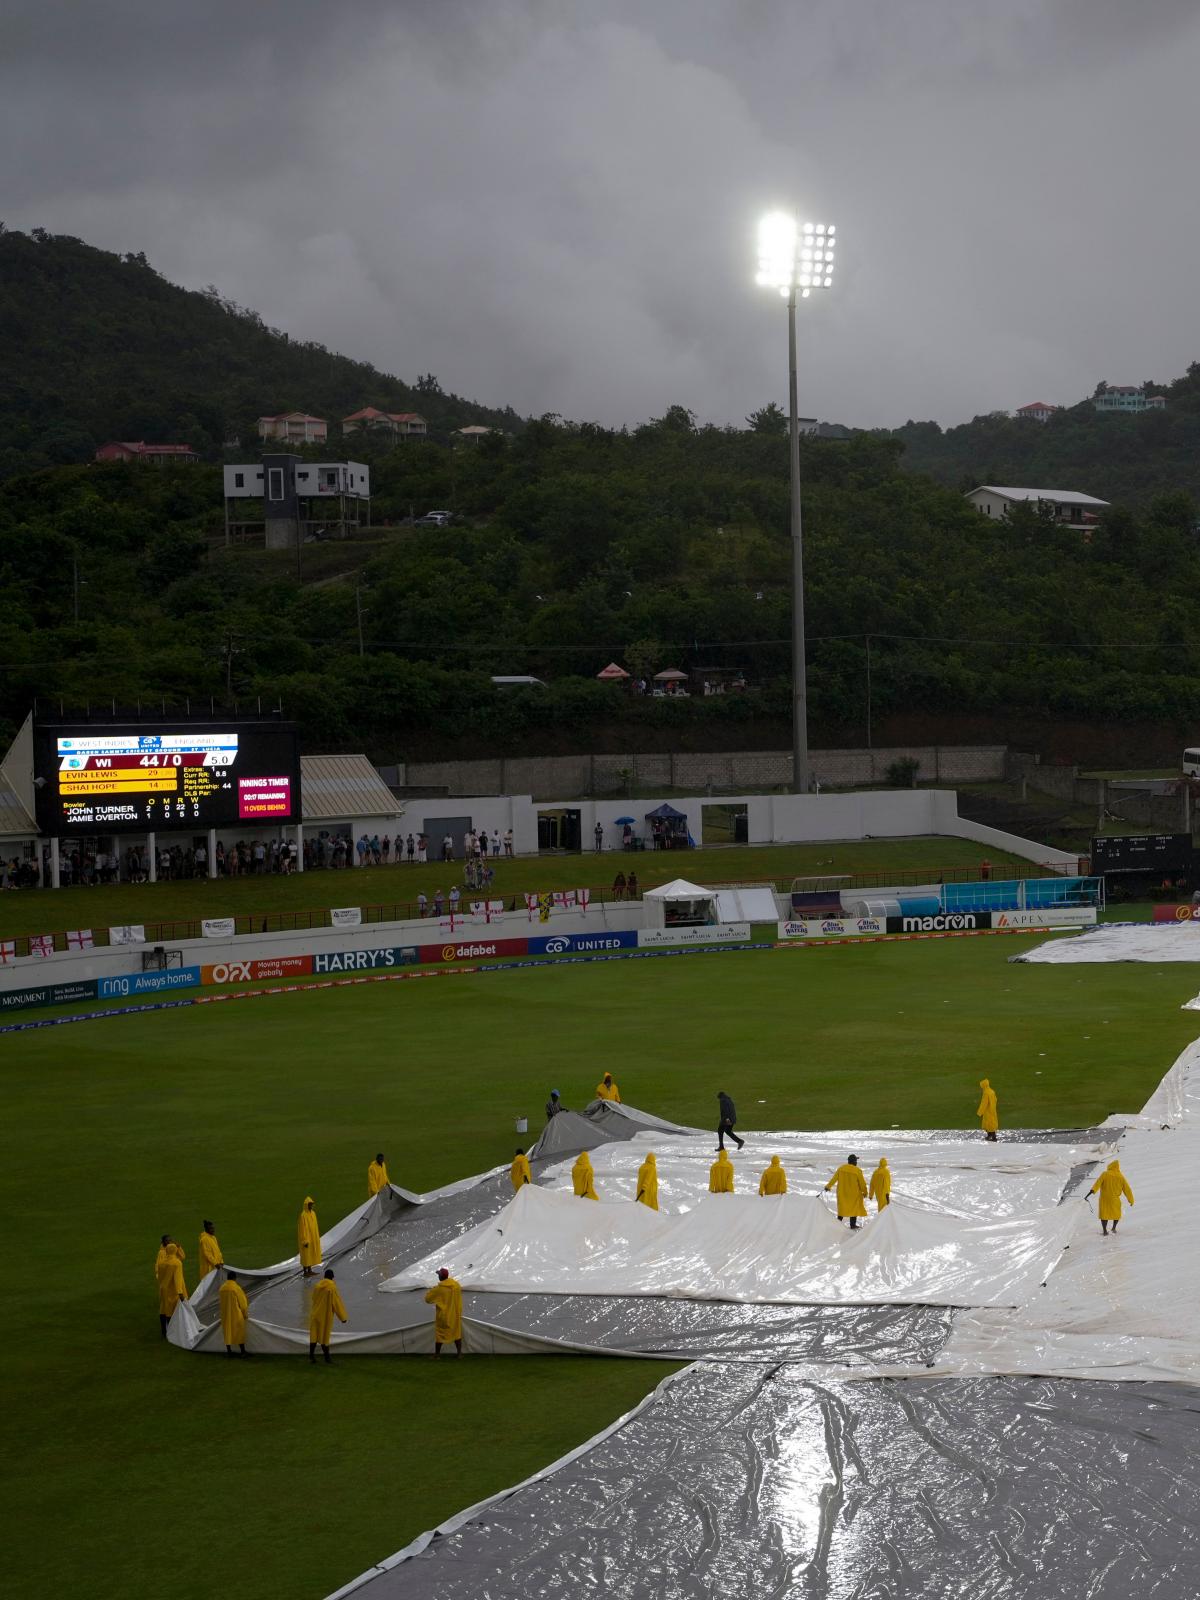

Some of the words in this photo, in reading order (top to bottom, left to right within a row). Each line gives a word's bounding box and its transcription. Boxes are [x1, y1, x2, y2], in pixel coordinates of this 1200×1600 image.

[95, 758, 112, 768] WI
[139, 755, 160, 767] 44
[172, 754, 182, 766] 0
[211, 756, 229, 765] 5.0
[91, 771, 118, 779] LEWIS
[239, 779, 267, 787] INNINGS
[268, 778, 289, 786] TIMER
[95, 805, 134, 813] TURNER
[95, 813, 138, 821] OVERTON
[903, 914, 976, 932] macron
[1012, 915, 1044, 924] APEX
[785, 927, 808, 935] WATERS
[456, 944, 497, 957] dafabet
[577, 939, 621, 951] UNITED
[257, 960, 280, 969] Moving
[281, 959, 302, 967] money
[315, 948, 395, 973] HARRY'S
[212, 961, 252, 984] OFX
[258, 968, 283, 979] globally
[103, 978, 129, 996] ring
[135, 976, 166, 989] Always
[2, 991, 46, 1006] MONUMENT
